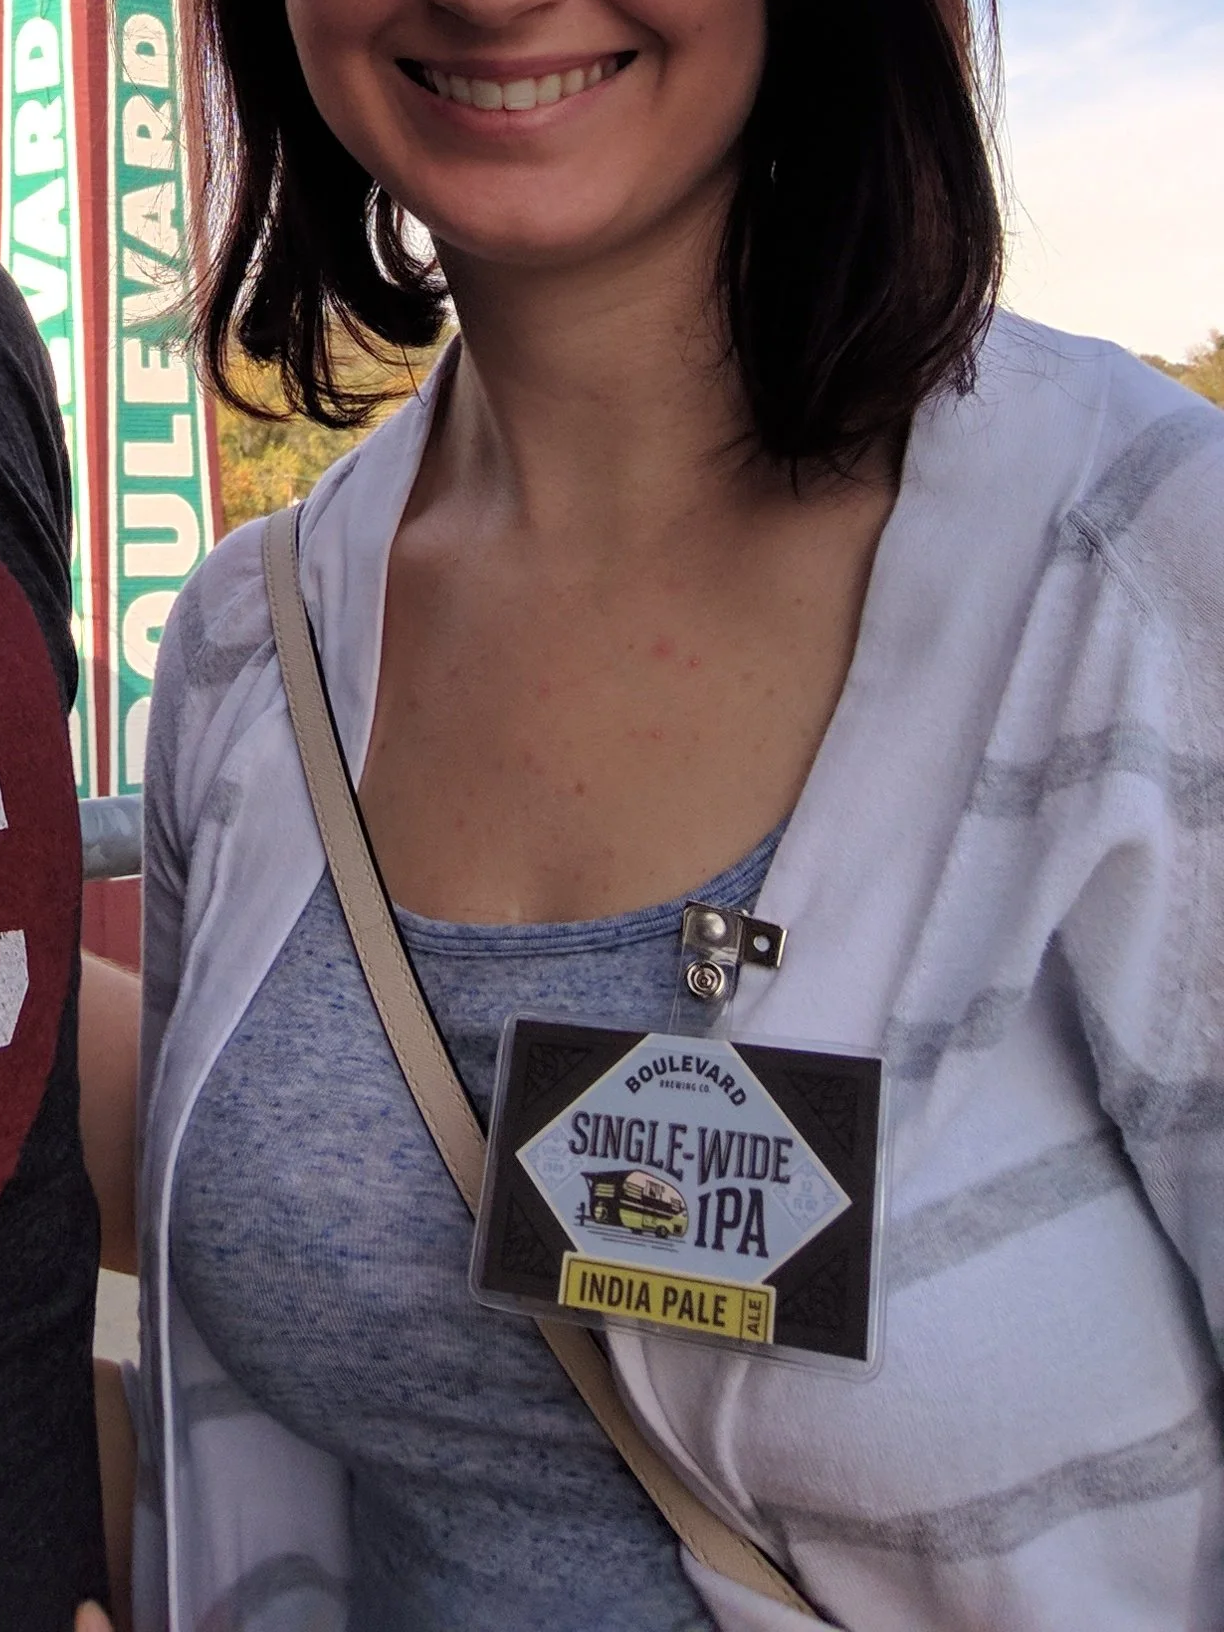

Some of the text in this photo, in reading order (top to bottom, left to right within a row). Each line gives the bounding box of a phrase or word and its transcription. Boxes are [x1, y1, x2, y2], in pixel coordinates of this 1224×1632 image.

[122, 13, 200, 785] OULEVARD
[624, 1055, 746, 1106] BOULEVARD
[659, 1079, 697, 1092] BREWING
[569, 1110, 793, 1185] SINGLE-WIDE
[694, 1187, 769, 1258] IPA
[580, 1271, 762, 1336] INDIA PALE ALE
